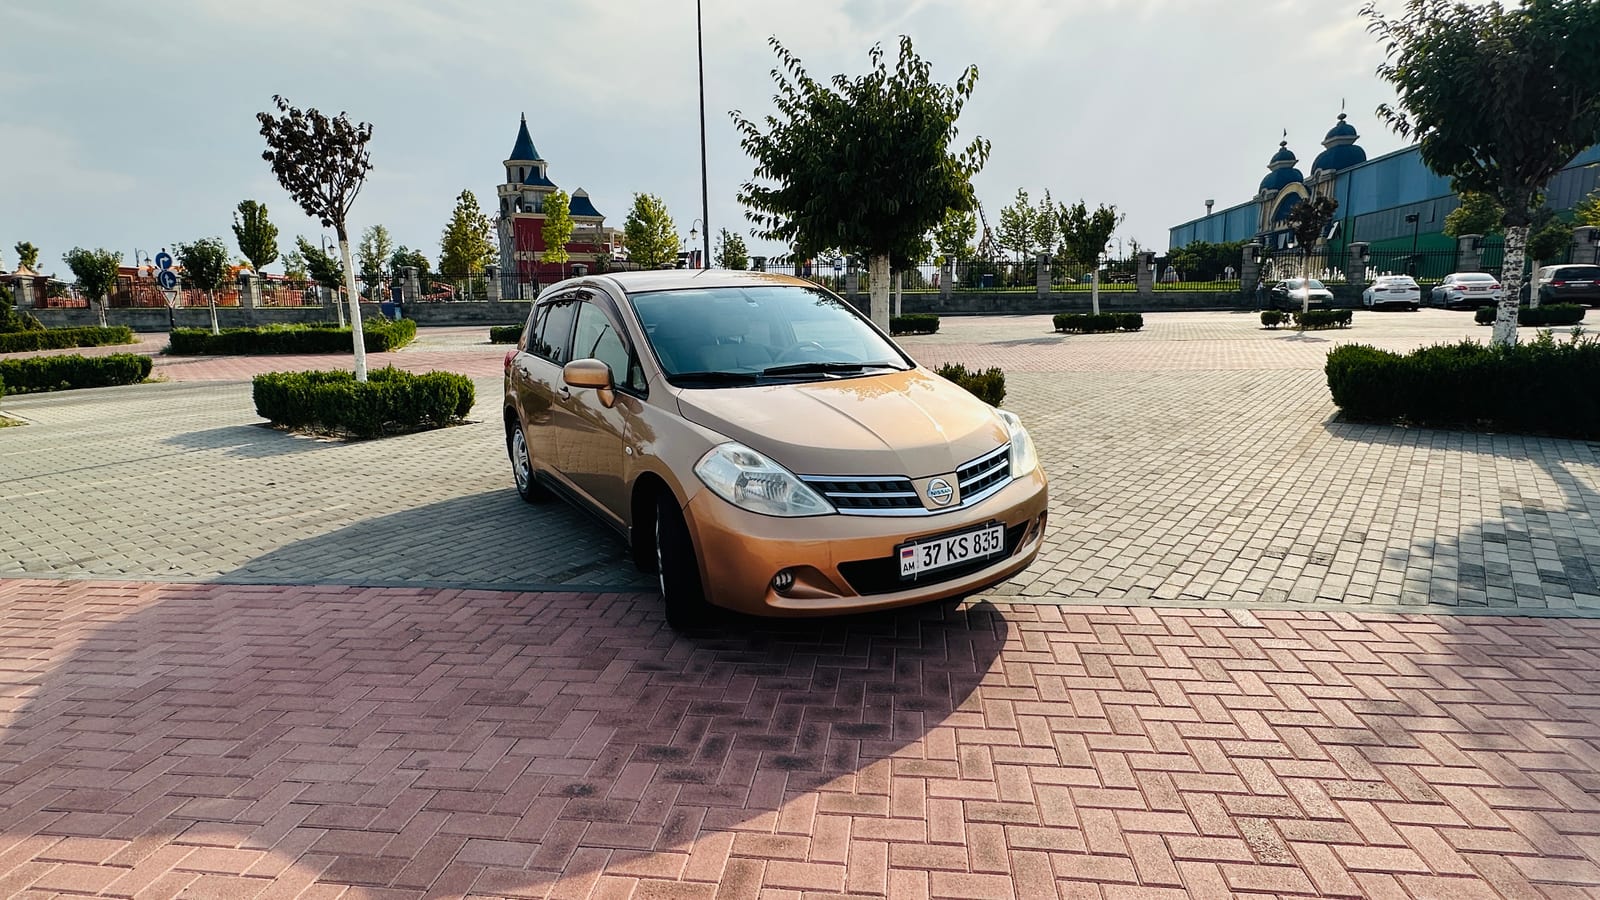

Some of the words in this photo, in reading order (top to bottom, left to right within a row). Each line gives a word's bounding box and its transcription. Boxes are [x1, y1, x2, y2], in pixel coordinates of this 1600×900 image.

[922, 543, 941, 567] 37
[947, 537, 969, 561] KS
[973, 529, 999, 554] 835
[903, 561, 915, 572] AM
